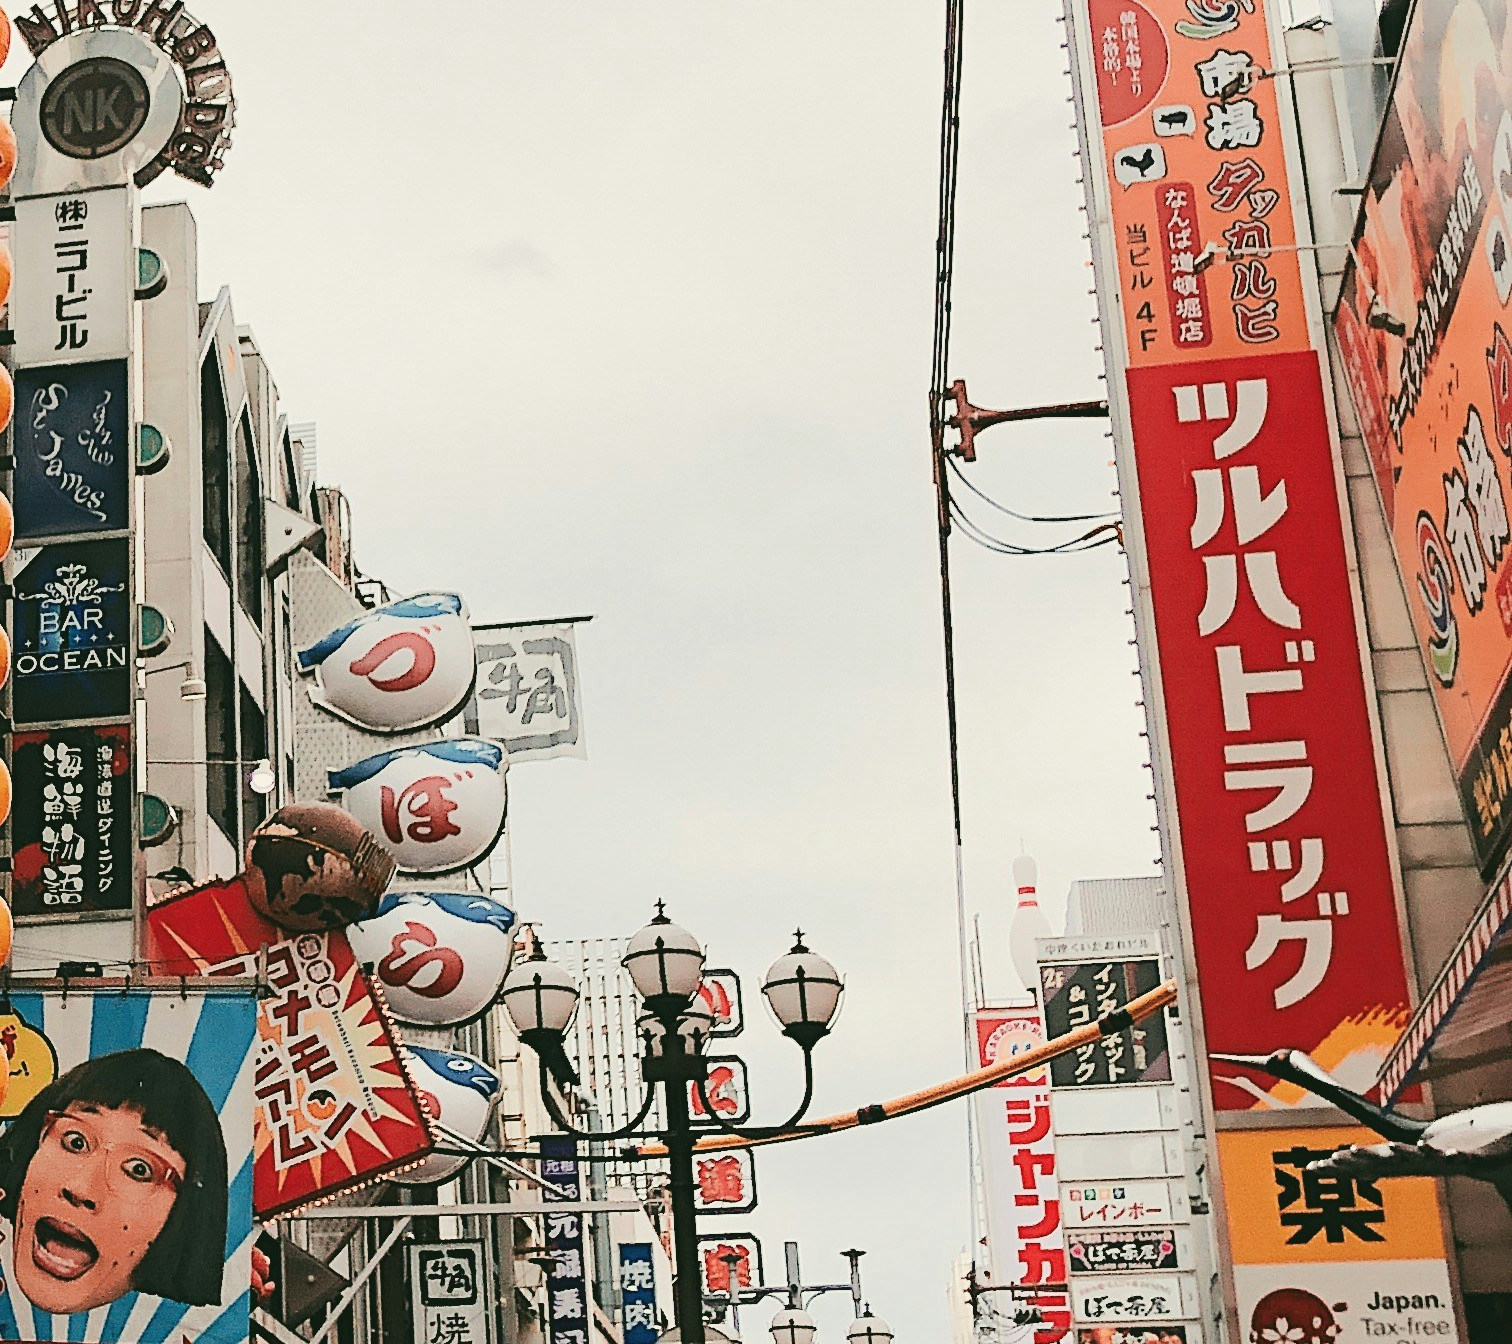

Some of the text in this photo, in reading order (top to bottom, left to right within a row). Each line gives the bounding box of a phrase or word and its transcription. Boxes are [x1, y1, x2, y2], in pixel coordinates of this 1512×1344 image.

[62, 85, 126, 135] NK
[1194, 48, 1279, 344] 市場タッカルビ
[1126, 222, 1154, 290] 当ビル
[1164, 186, 1205, 345] なんば道頓堀店
[37, 430, 108, 522] James
[39, 607, 104, 633] BAR
[16, 646, 127, 675] OCEAN
[1172, 377, 1350, 1011] ツルハドラッグ
[41, 741, 85, 906] 海鮮物語
[1042, 967, 1066, 990] 2F
[1068, 984, 1096, 1084] &コック
[1092, 963, 1127, 1083] インタネット
[1272, 1144, 1388, 1246] 薬
[427, 1260, 471, 1294] 牛角
[619, 1259, 656, 1331] 焼肉
[1367, 1290, 1447, 1313] Japan.
[1360, 1316, 1452, 1340] Tax-free
